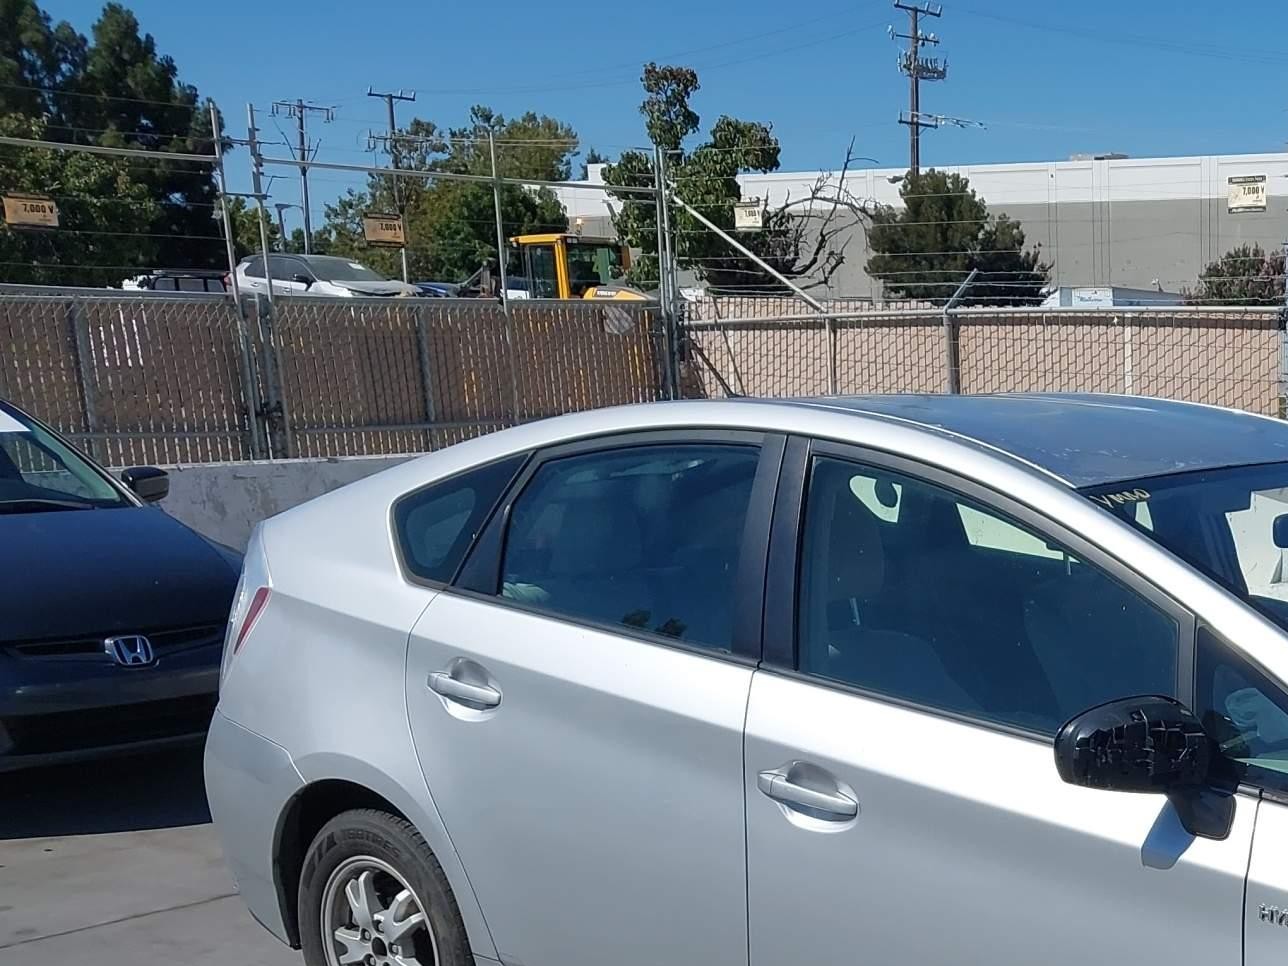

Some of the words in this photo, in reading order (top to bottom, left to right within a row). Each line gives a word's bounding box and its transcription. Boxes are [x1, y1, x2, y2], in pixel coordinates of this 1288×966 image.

[1242, 186, 1260, 196] 7,000
[22, 203, 47, 213] 7,000
[48, 204, 54, 214] V
